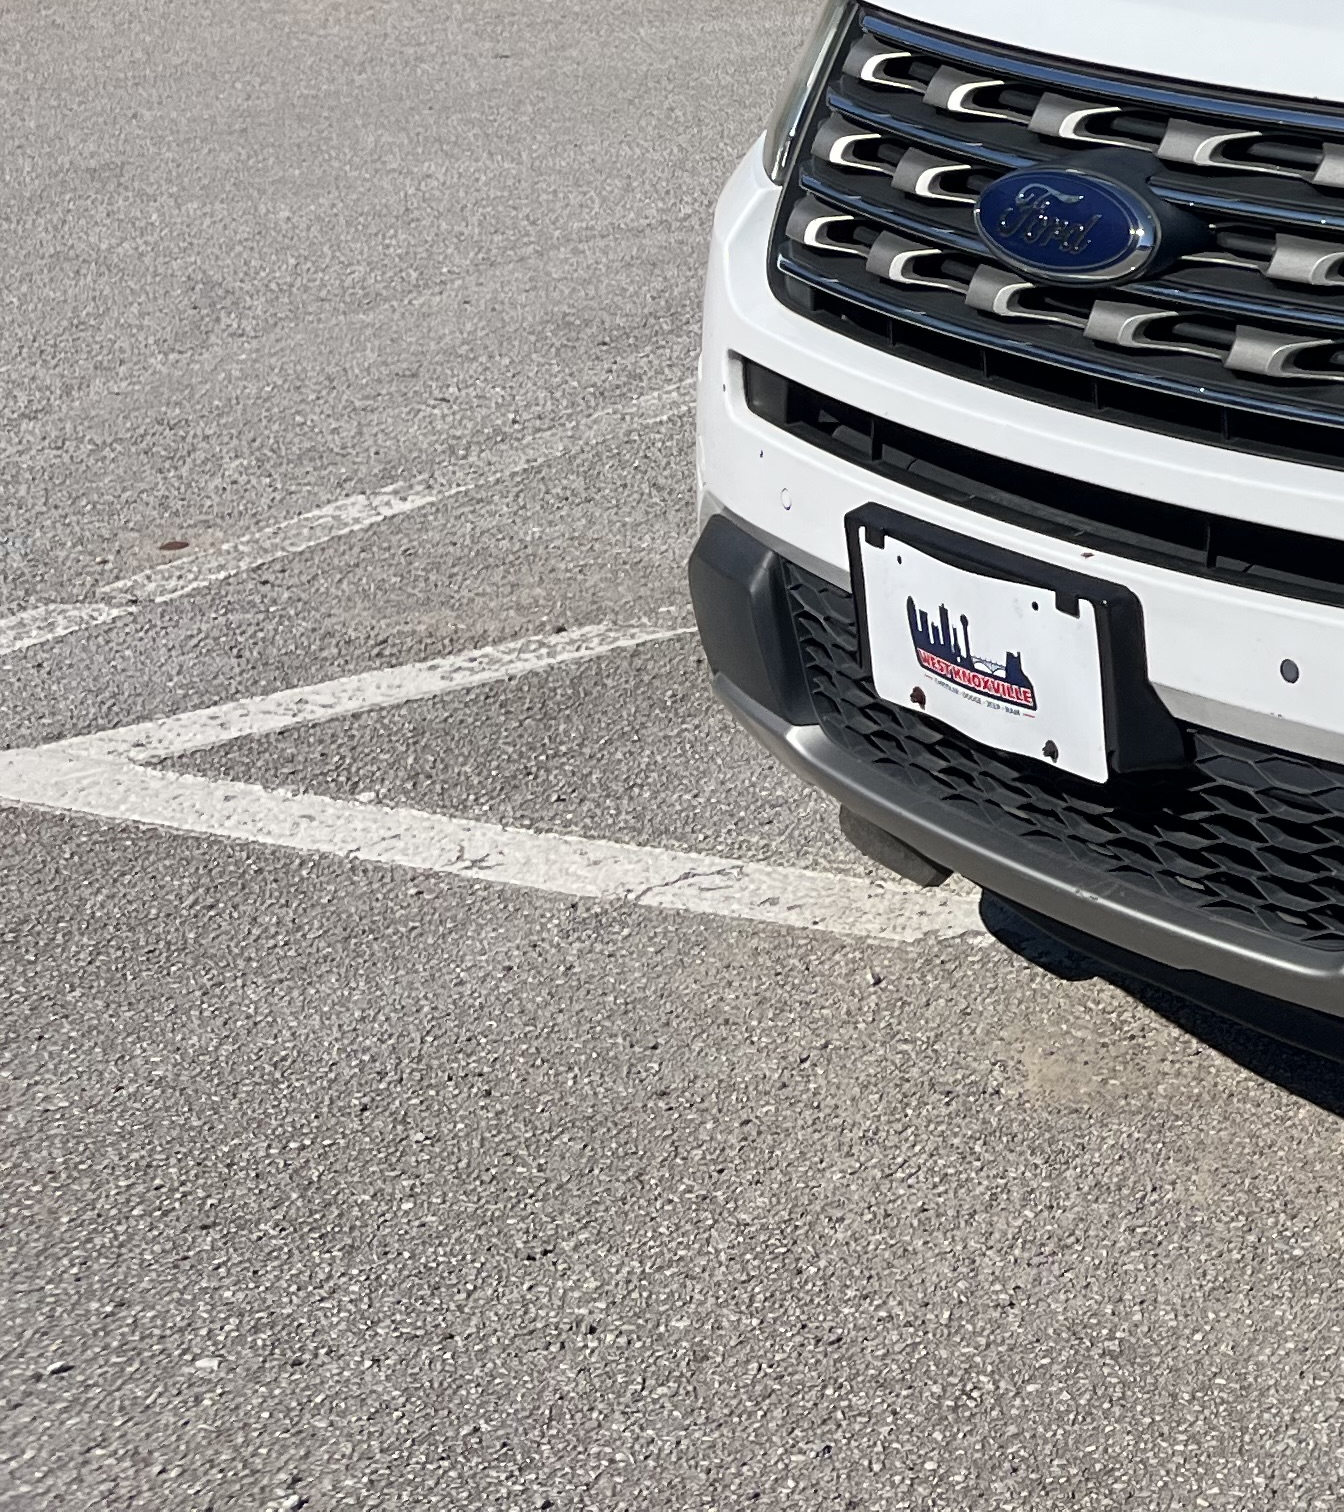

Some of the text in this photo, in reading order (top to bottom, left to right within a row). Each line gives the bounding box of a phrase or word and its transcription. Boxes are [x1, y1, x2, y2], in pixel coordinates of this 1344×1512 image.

[998, 183, 1102, 255] Ford
[919, 649, 951, 677] WEST
[952, 668, 1032, 705] KNOXVILLE
